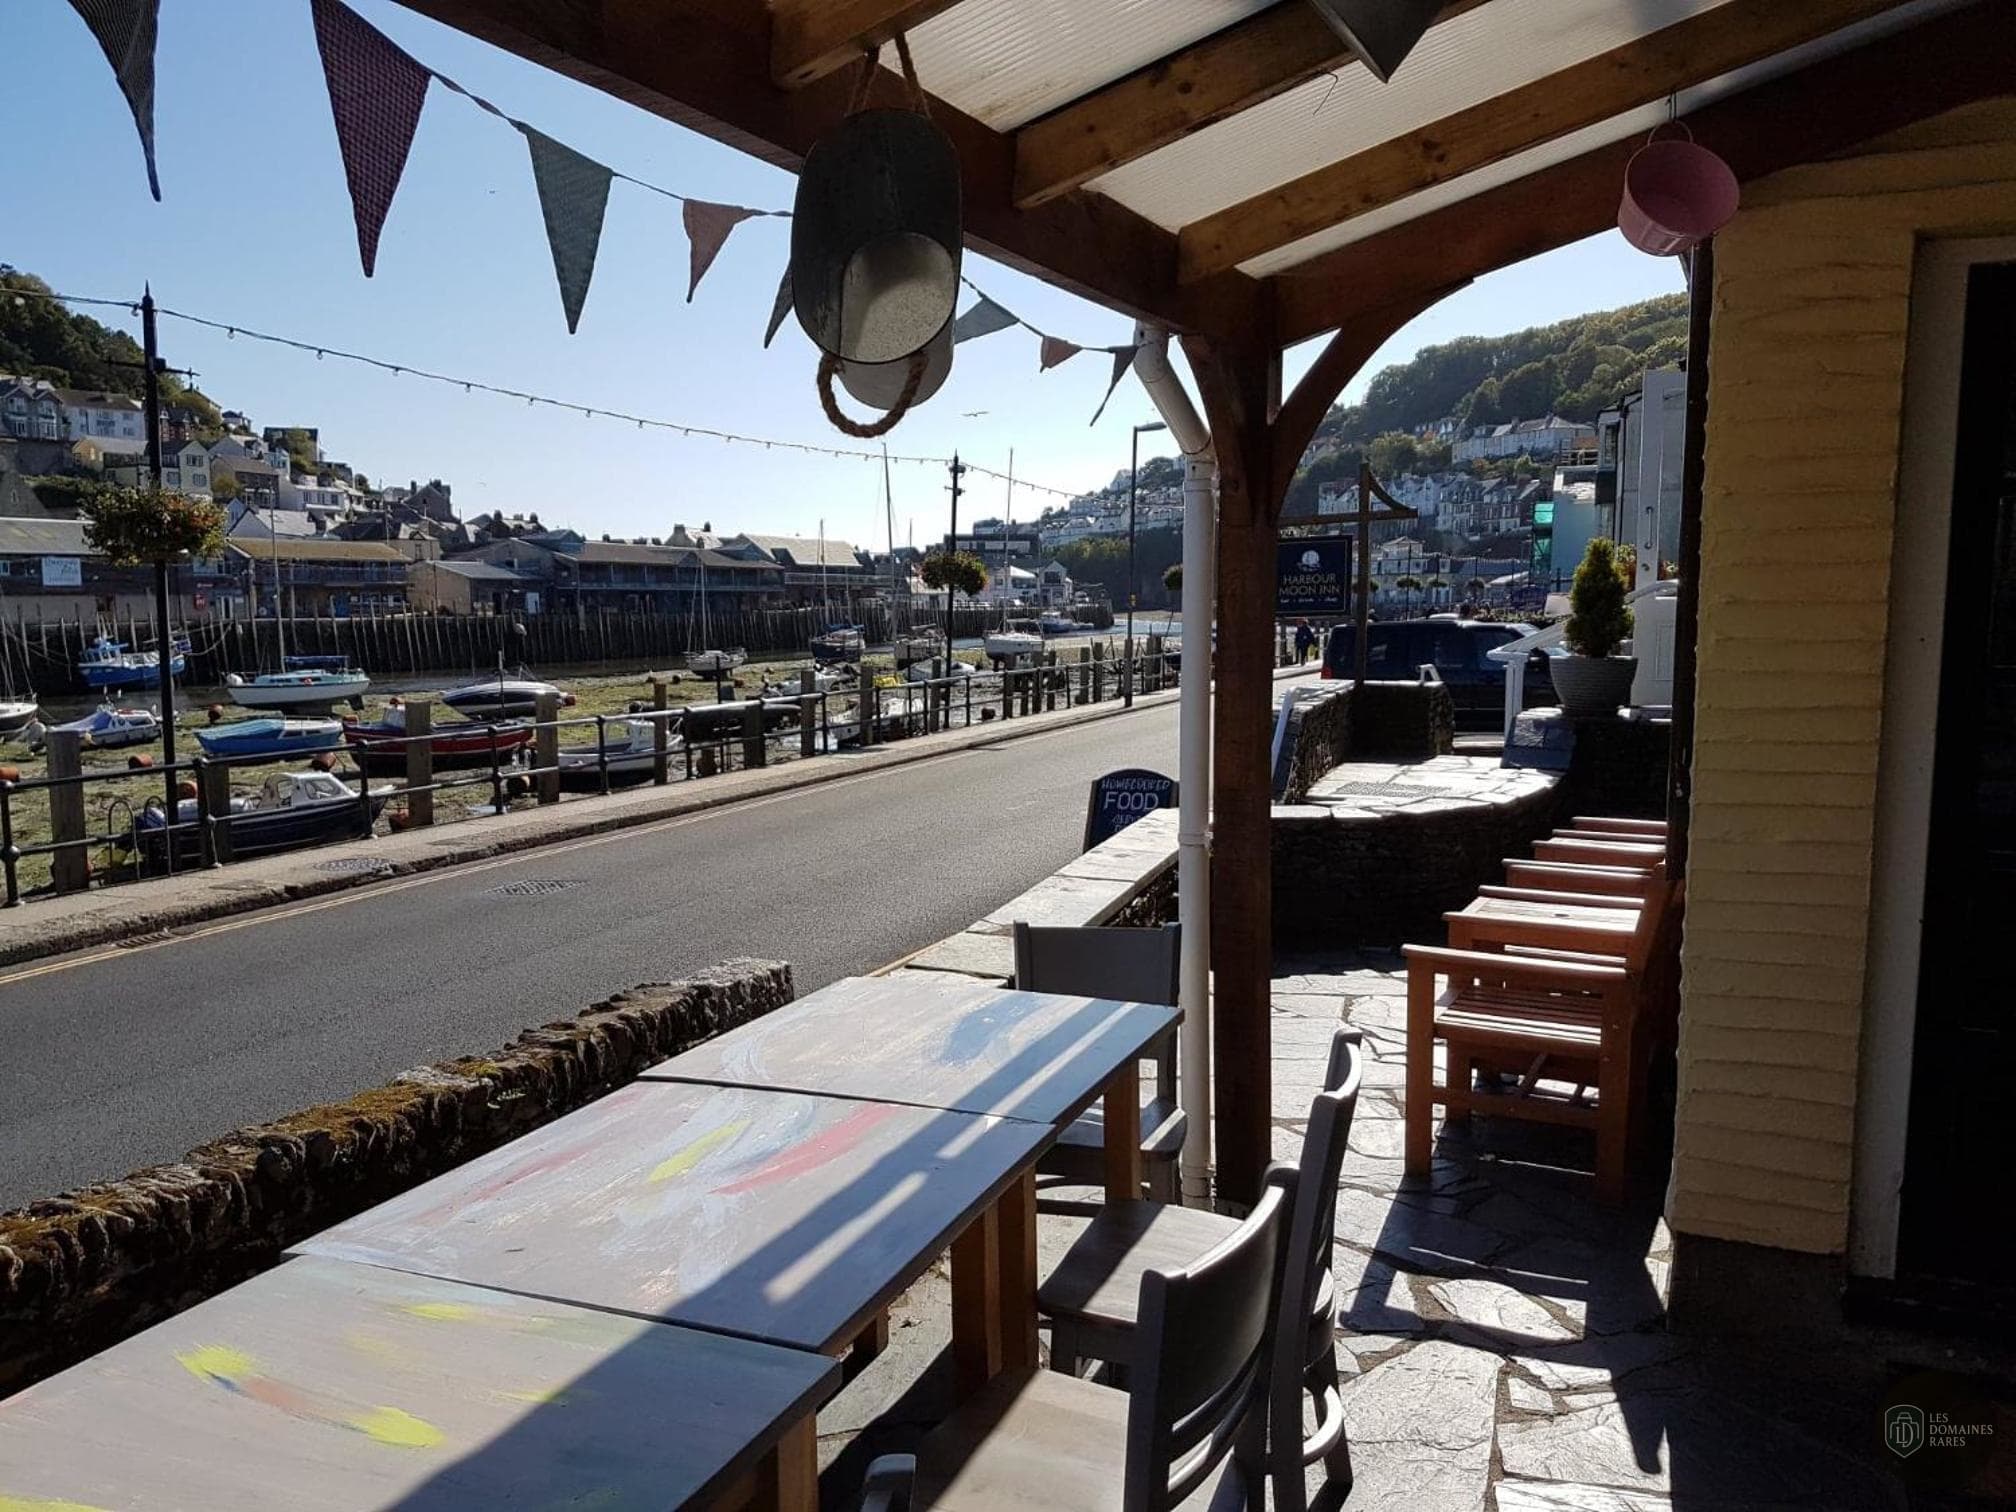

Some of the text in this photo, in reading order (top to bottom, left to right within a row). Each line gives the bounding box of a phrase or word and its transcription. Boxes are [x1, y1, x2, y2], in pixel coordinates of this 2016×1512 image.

[1283, 573, 1336, 585] HARBOUR
[1279, 585, 1317, 597] MOON
[1103, 791, 1159, 811] FOOD
